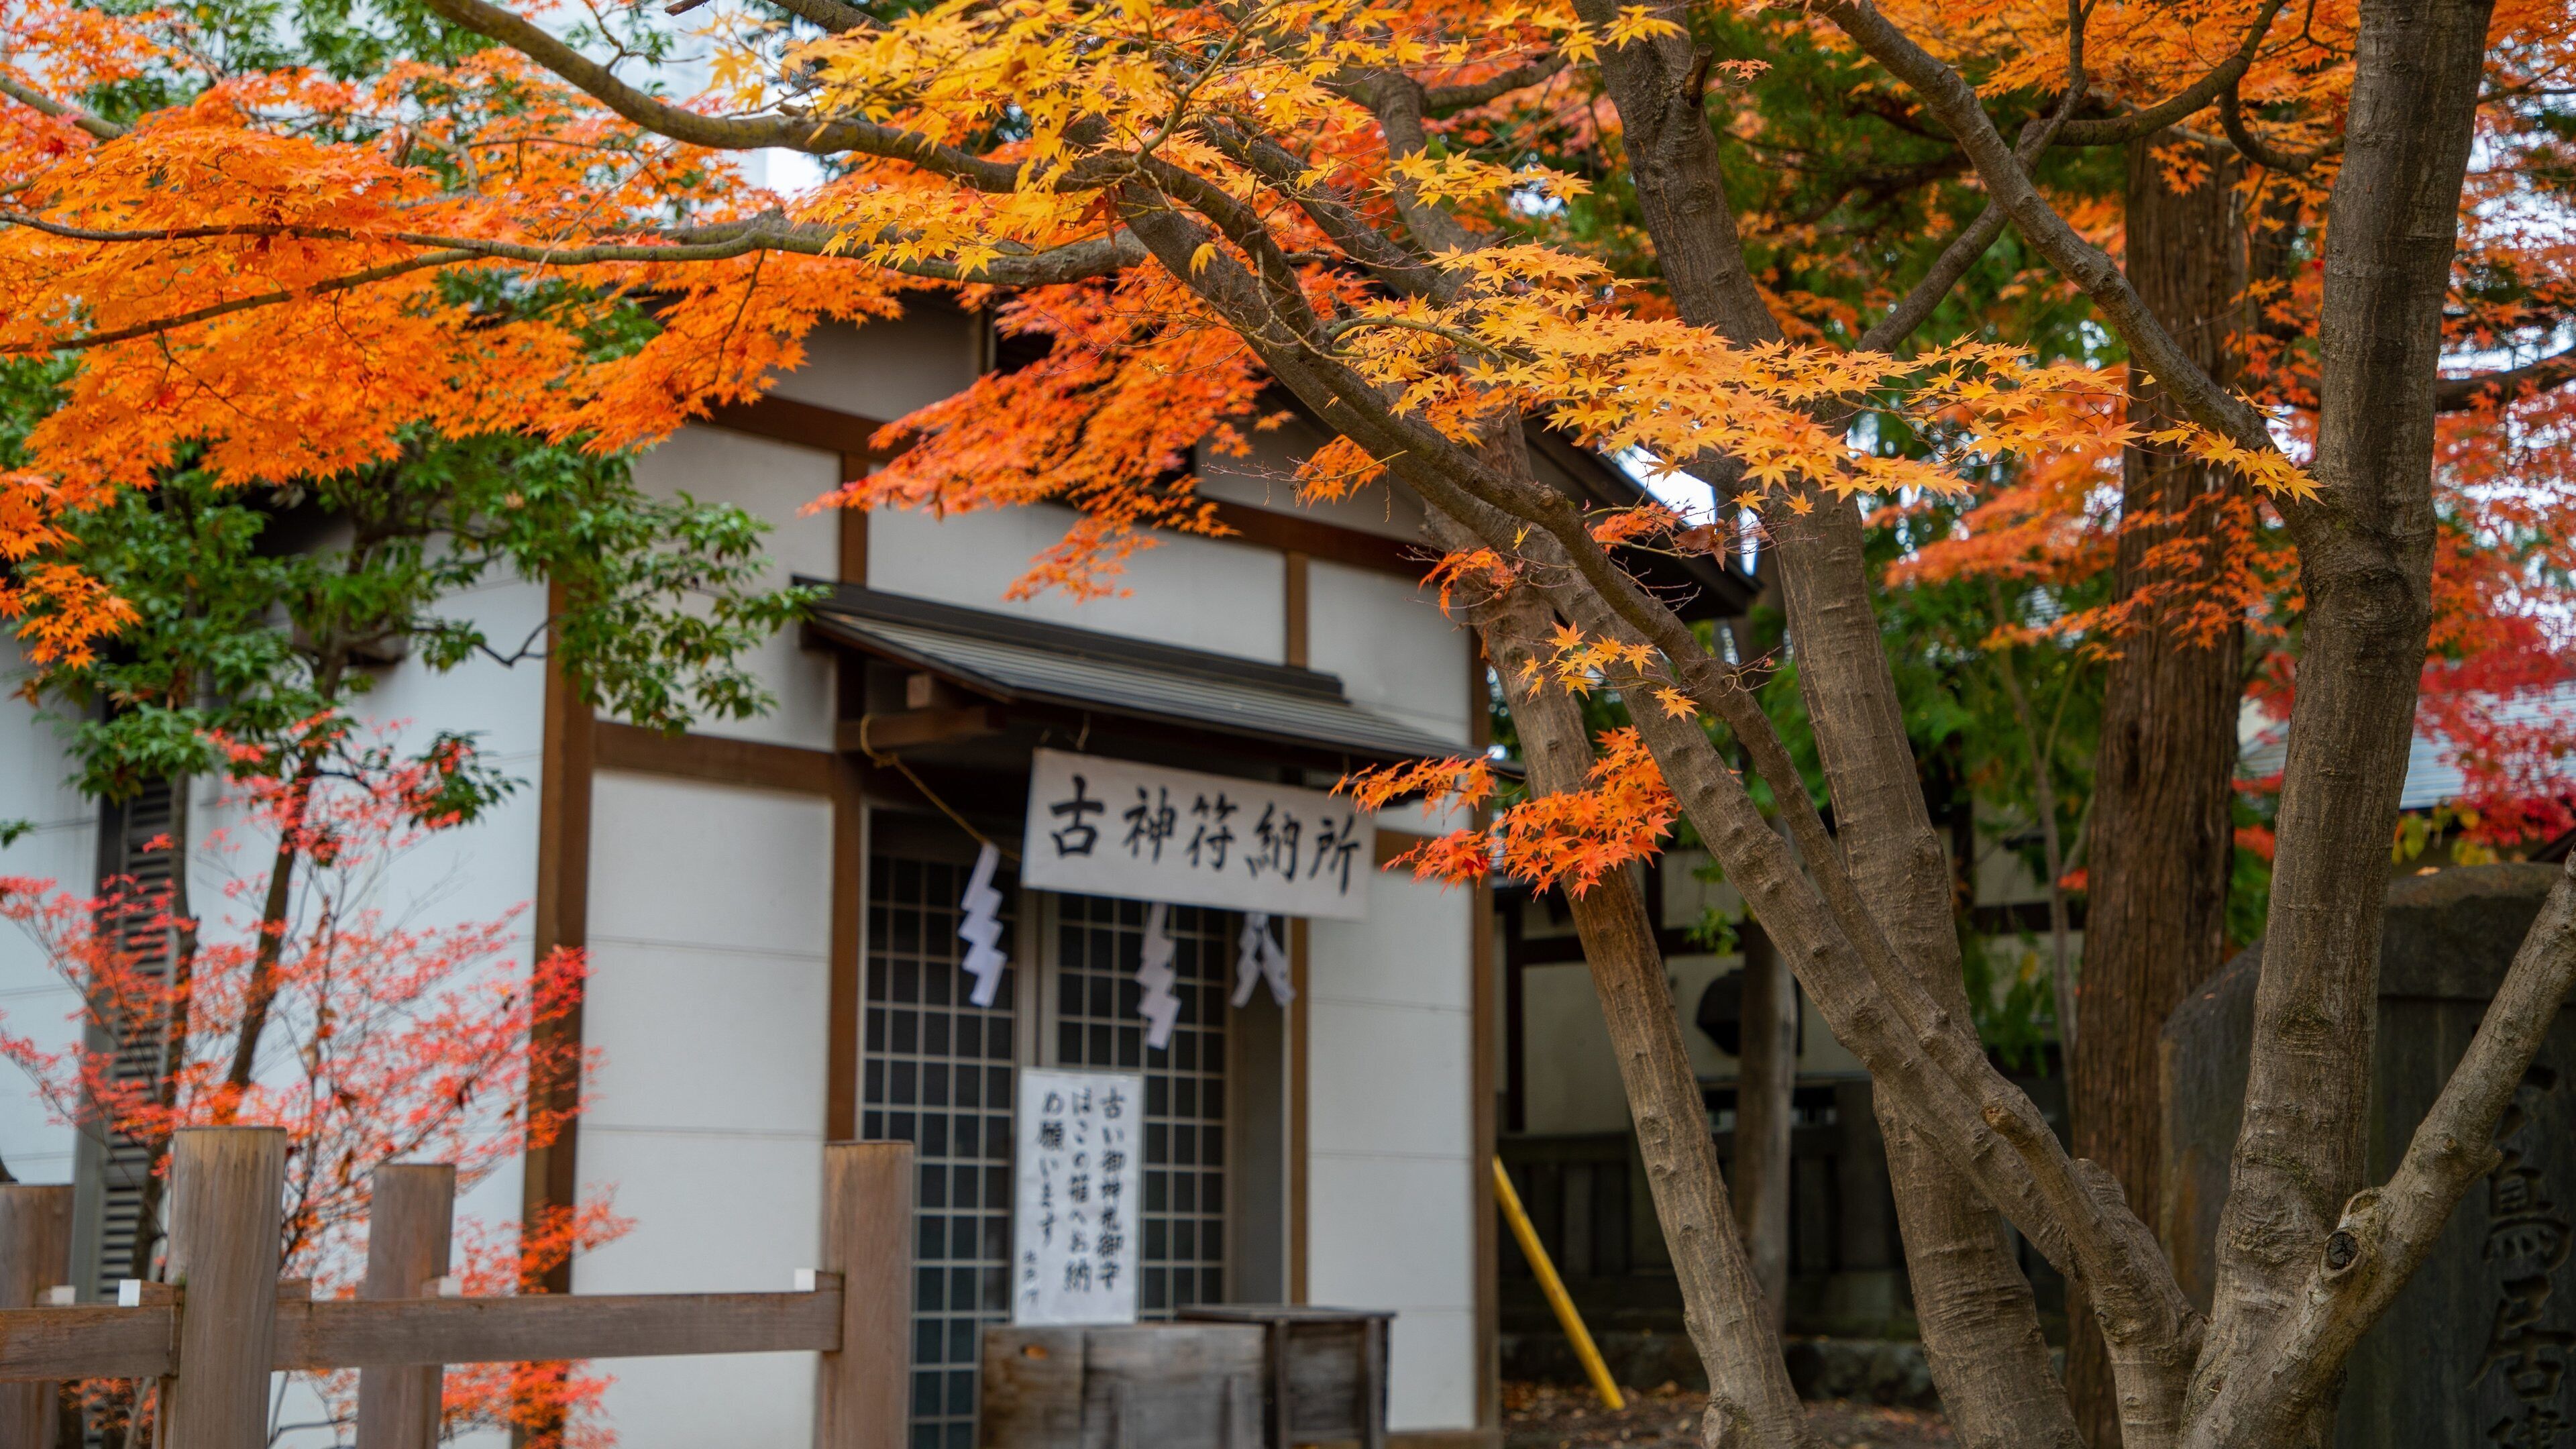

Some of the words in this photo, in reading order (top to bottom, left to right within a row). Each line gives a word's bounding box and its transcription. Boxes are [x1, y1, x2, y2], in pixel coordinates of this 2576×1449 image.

[1049, 774, 1361, 896] 古神符納所
[1037, 1091, 1063, 1246] め願います
[1064, 1086, 1091, 1292] はこの箱へお納
